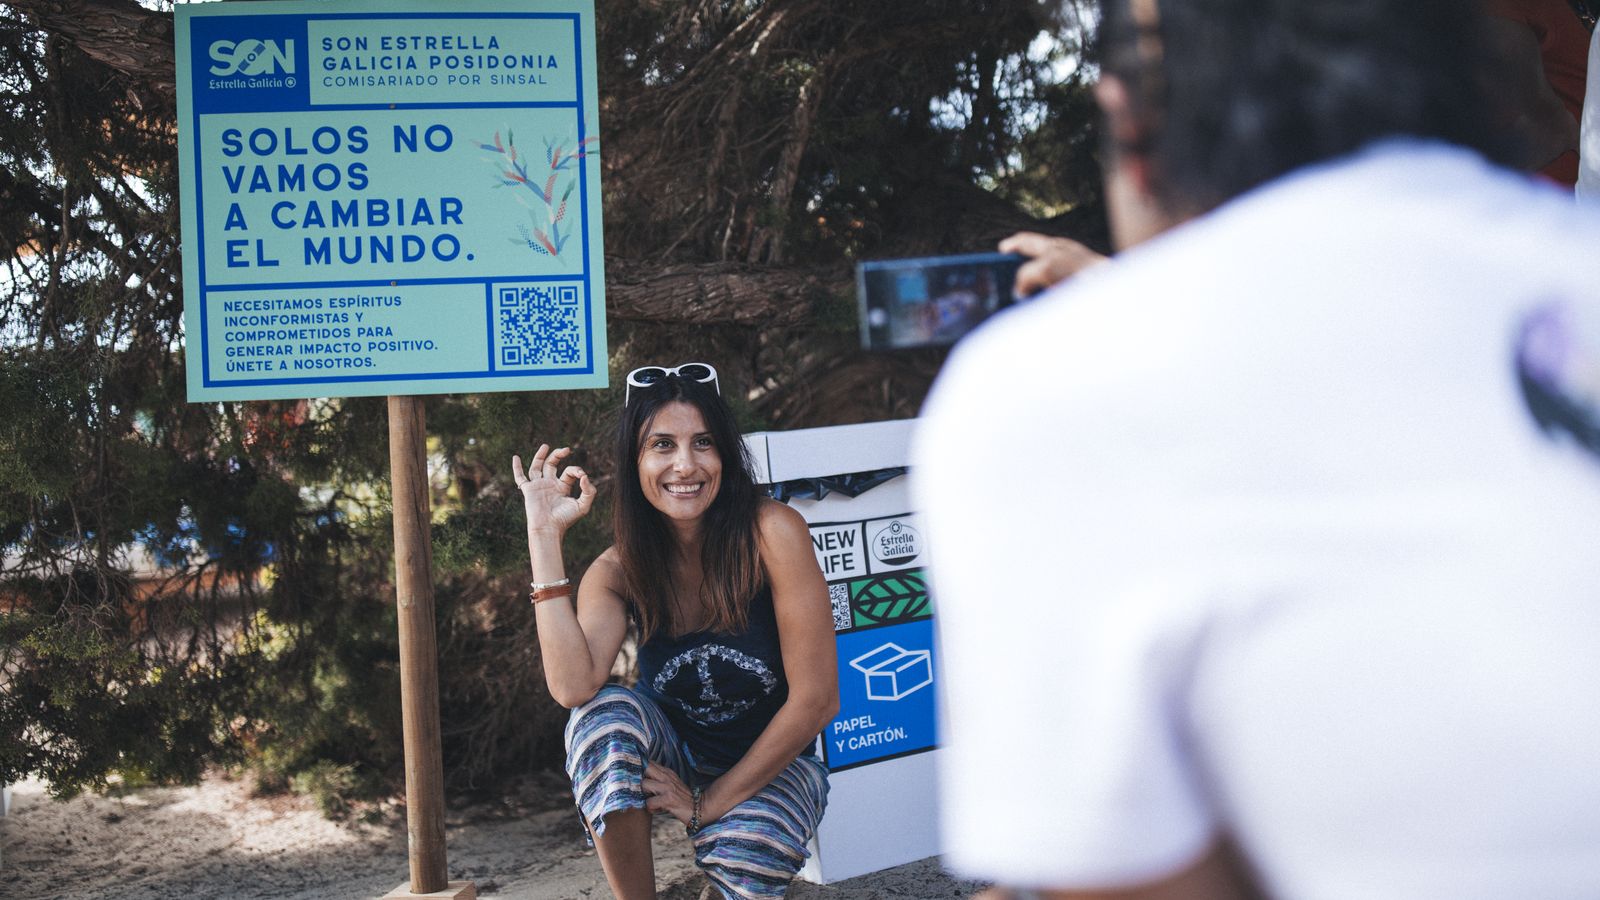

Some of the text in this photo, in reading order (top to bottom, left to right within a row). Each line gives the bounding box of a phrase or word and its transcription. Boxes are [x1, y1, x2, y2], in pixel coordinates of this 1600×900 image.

[322, 35, 500, 51] SON ESTRELLA
[208, 38, 296, 77] SON
[322, 54, 558, 71] GALICIA POSIDONIA
[208, 78, 283, 90] Estrella Galicia
[323, 74, 547, 87] COMISARIADO POR SINSAL
[221, 124, 453, 157] SOLOS NO
[221, 162, 369, 194] VAMOS
[224, 197, 464, 231] A CAMBIAR
[226, 233, 475, 268] EL MUNDO.
[224, 295, 402, 312] NECESITAMOS ESPÍRITUS
[224, 312, 364, 327] INCONFORMISTAS Y
[225, 326, 393, 342] COMPROMETIDOS PARA
[225, 339, 438, 358] GENERAR IMPACTO POSITIVO.
[226, 357, 376, 372] ÚNETE A NOSOTROS.
[880, 533, 914, 546] Estrella
[882, 543, 914, 557] Galicia
[823, 552, 855, 574] IFE
[834, 715, 876, 735] PAPEL
[835, 727, 908, 752] Y CARTÓN.
